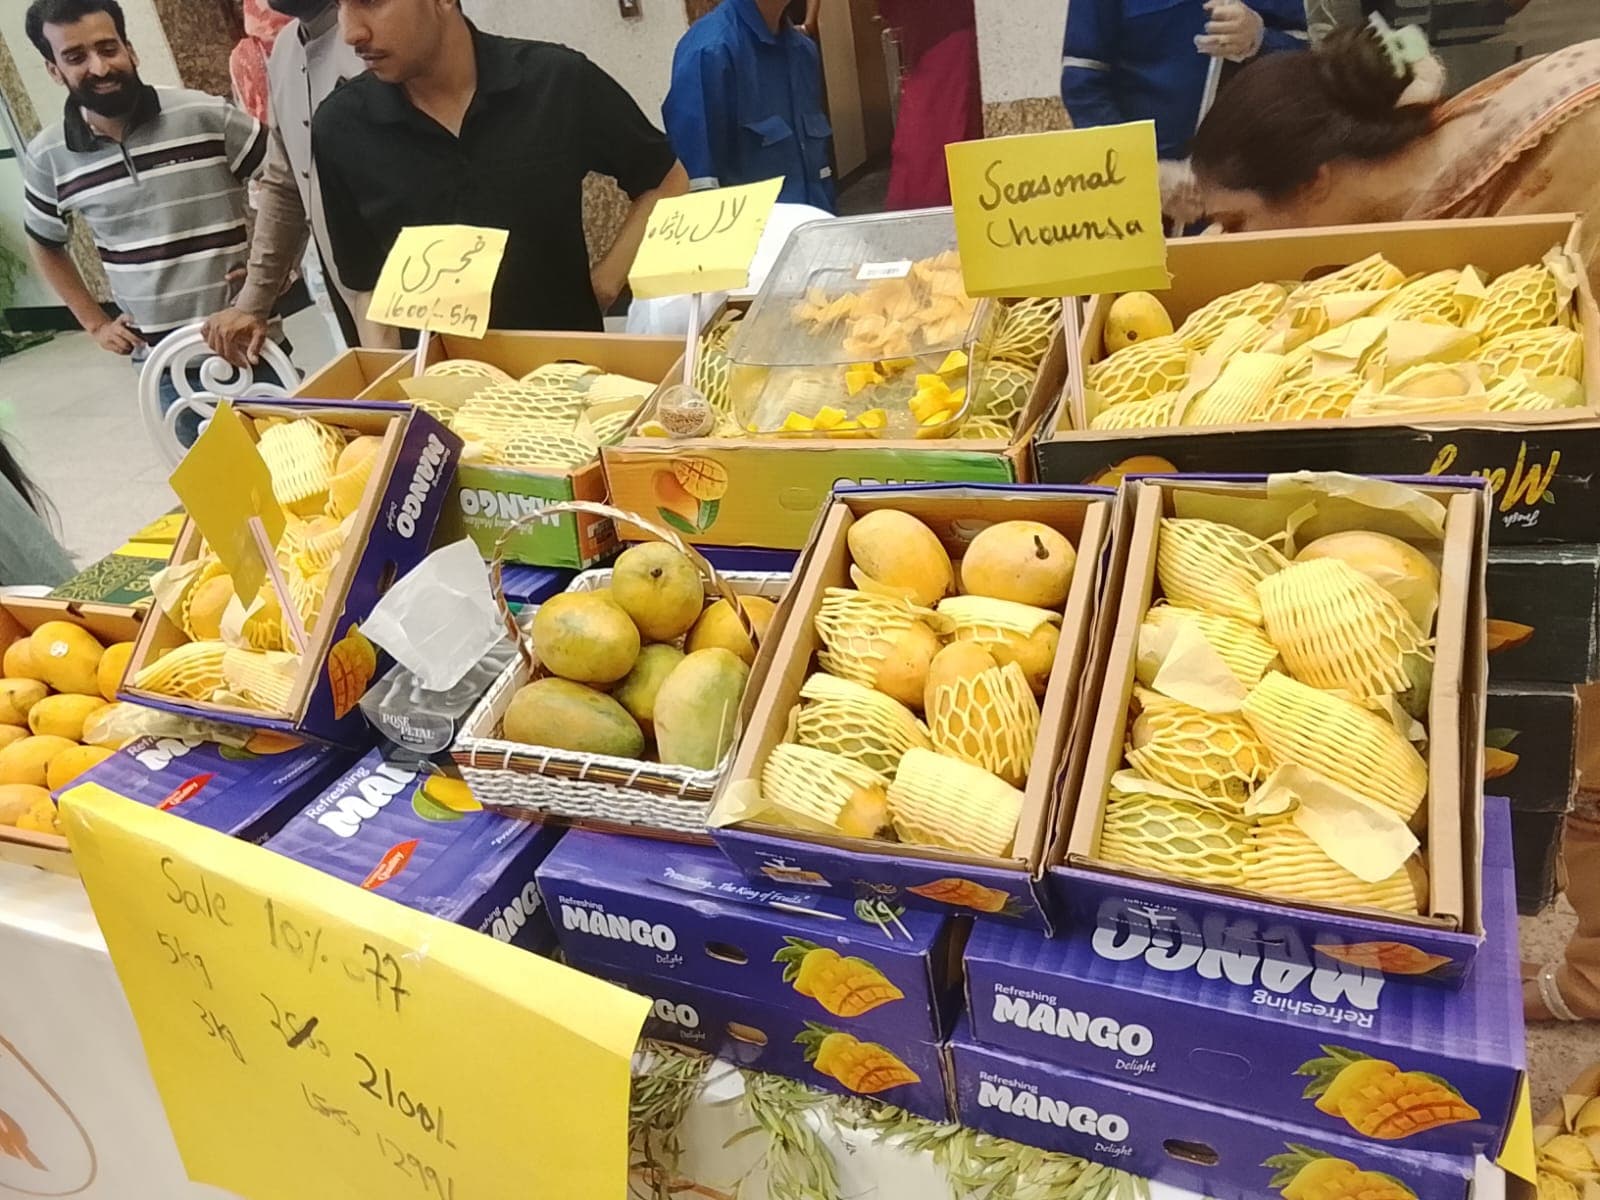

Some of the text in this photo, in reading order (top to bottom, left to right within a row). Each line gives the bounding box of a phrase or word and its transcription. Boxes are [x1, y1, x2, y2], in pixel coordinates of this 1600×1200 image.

[979, 148, 1126, 211] Seasonal
[397, 432, 446, 539] MANGO
[459, 488, 561, 528] MANGO
[306, 766, 370, 819] Refreshing
[161, 856, 233, 928] Sale
[559, 895, 604, 912] Refreshing
[561, 905, 677, 952] MANGO
[156, 929, 213, 990] 5kg
[994, 982, 1058, 1006] Refreshing
[1251, 988, 1375, 1029] Refreshing
[992, 993, 1154, 1057] MANGO
[979, 1071, 1039, 1095] Refreshing
[1115, 1058, 1157, 1076] Delight
[977, 1080, 1130, 1142] MANGO
[1094, 1142, 1133, 1156] Delight
